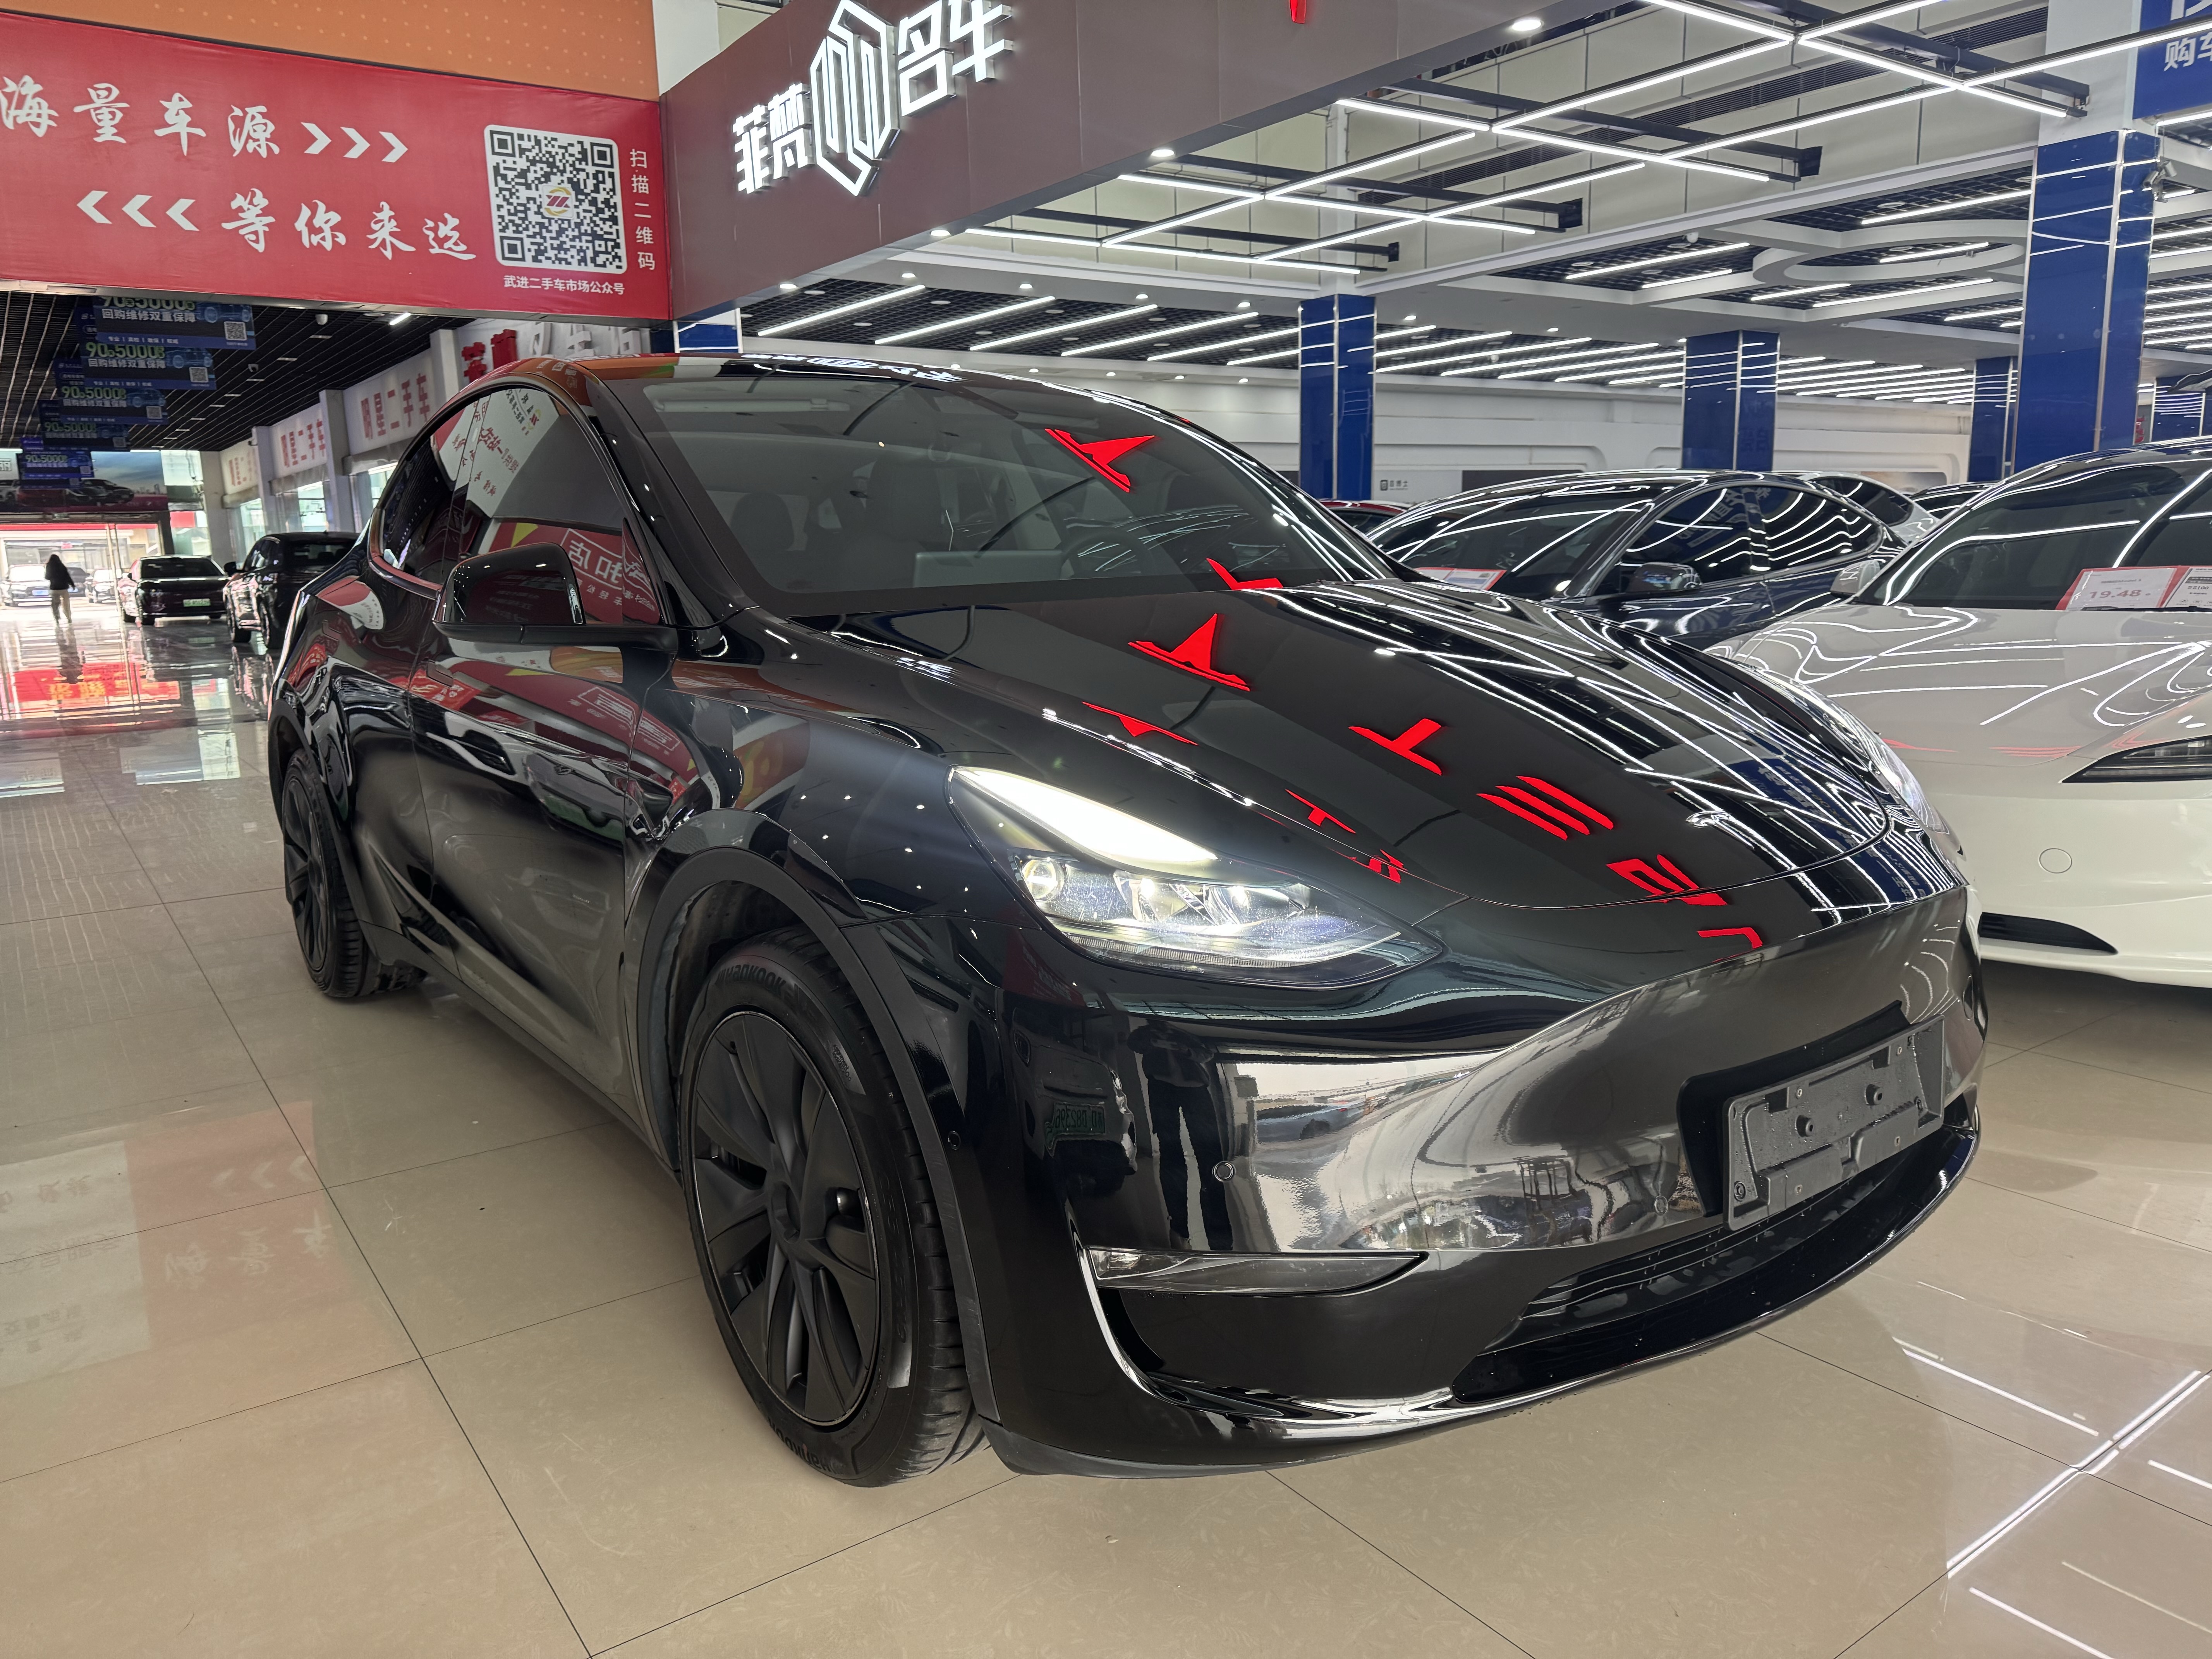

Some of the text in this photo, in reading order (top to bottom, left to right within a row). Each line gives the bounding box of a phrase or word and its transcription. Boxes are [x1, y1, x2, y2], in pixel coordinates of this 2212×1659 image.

[0, 76, 280, 158] 海量车源
[222, 188, 476, 261] 等你来选
[629, 148, 656, 270] 扫描二维码
[503, 275, 625, 295] 武进二手车市场公众号
[102, 309, 196, 323] 回购维修双重保障
[2090, 589, 2142, 599] 19.48
